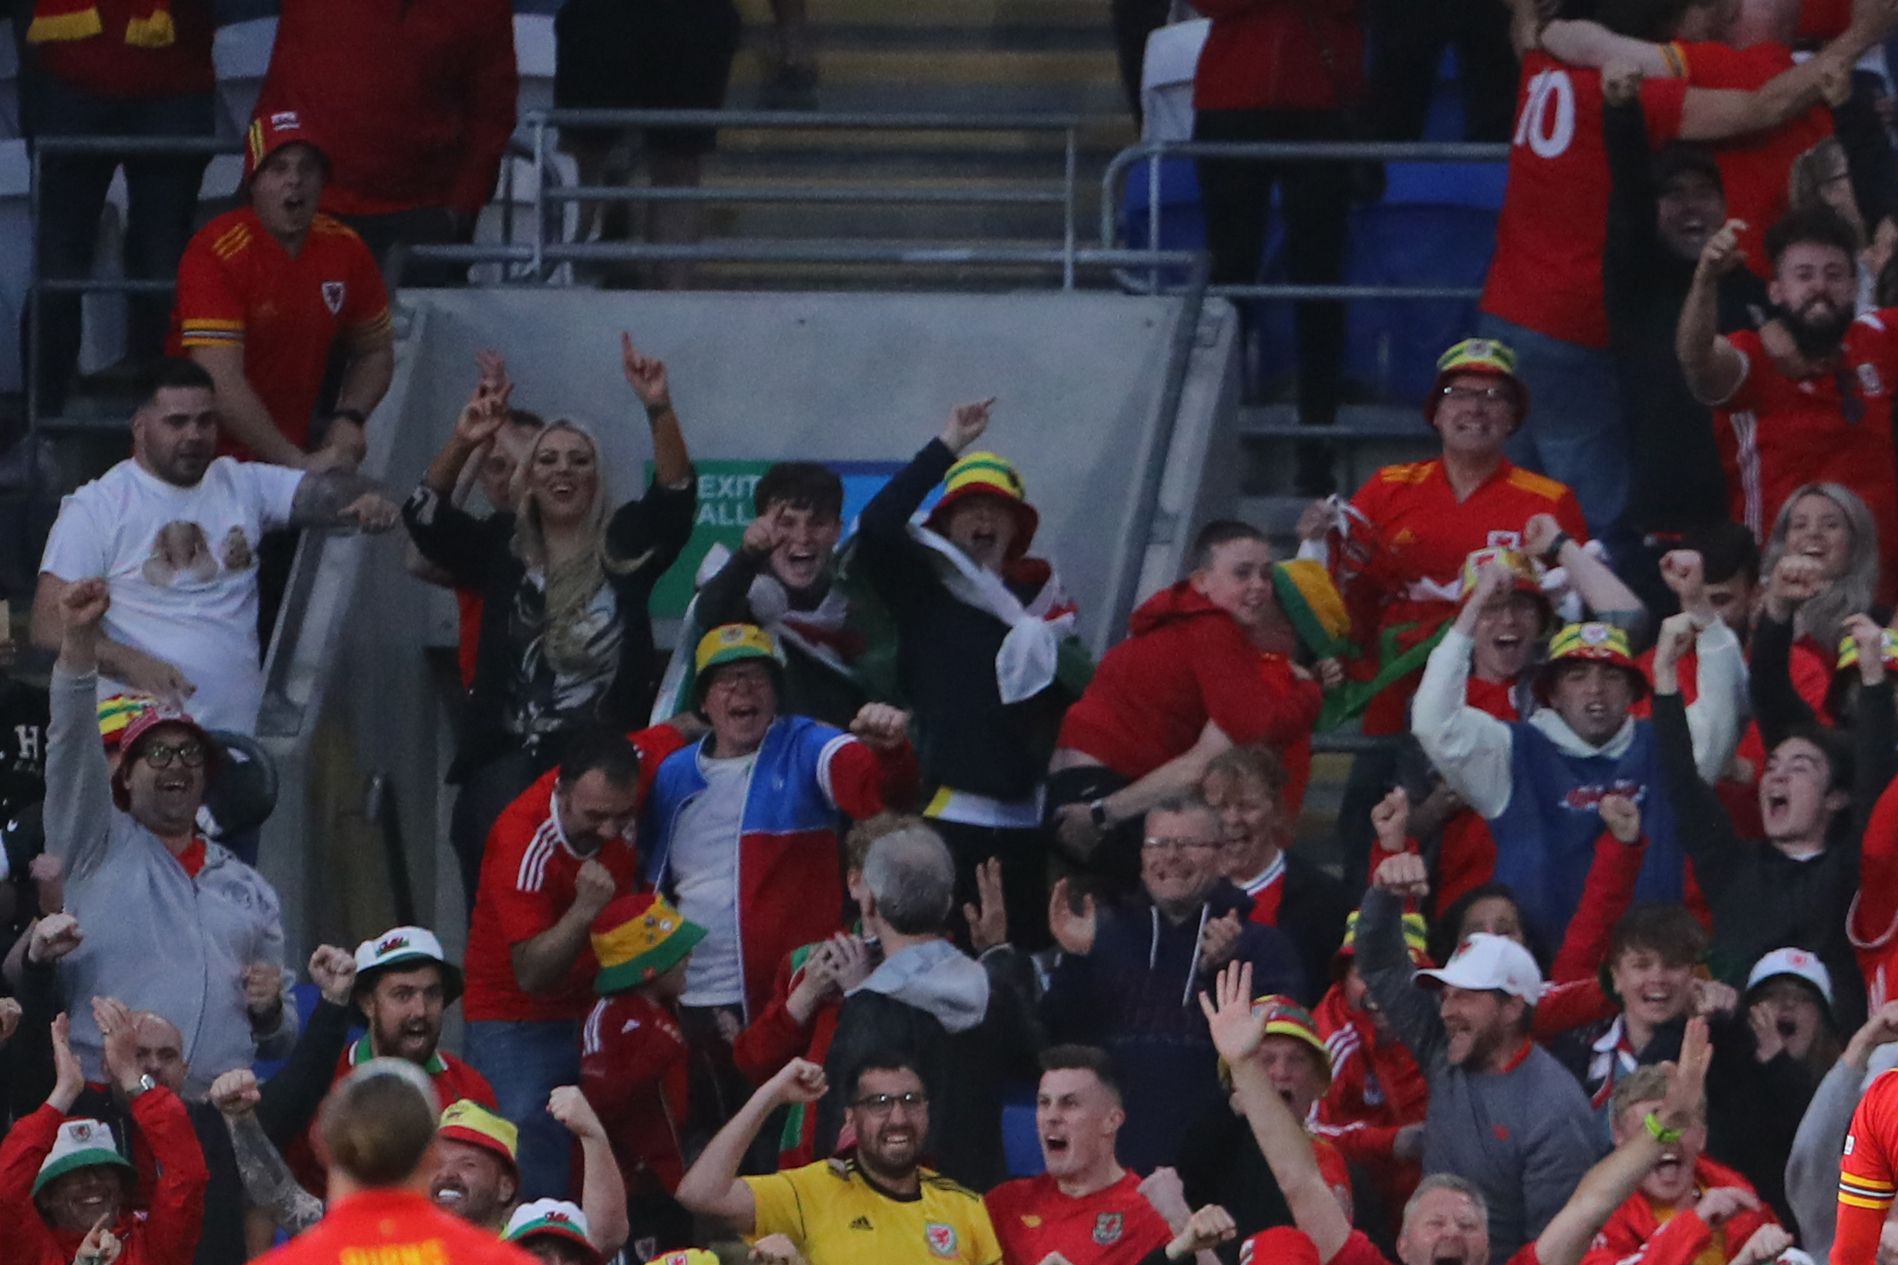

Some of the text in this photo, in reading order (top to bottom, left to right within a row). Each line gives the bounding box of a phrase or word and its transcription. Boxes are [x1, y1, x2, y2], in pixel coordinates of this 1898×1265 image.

[1513, 67, 1576, 159] 10
[697, 474, 763, 499] EXIT
[695, 501, 752, 526] ALL
